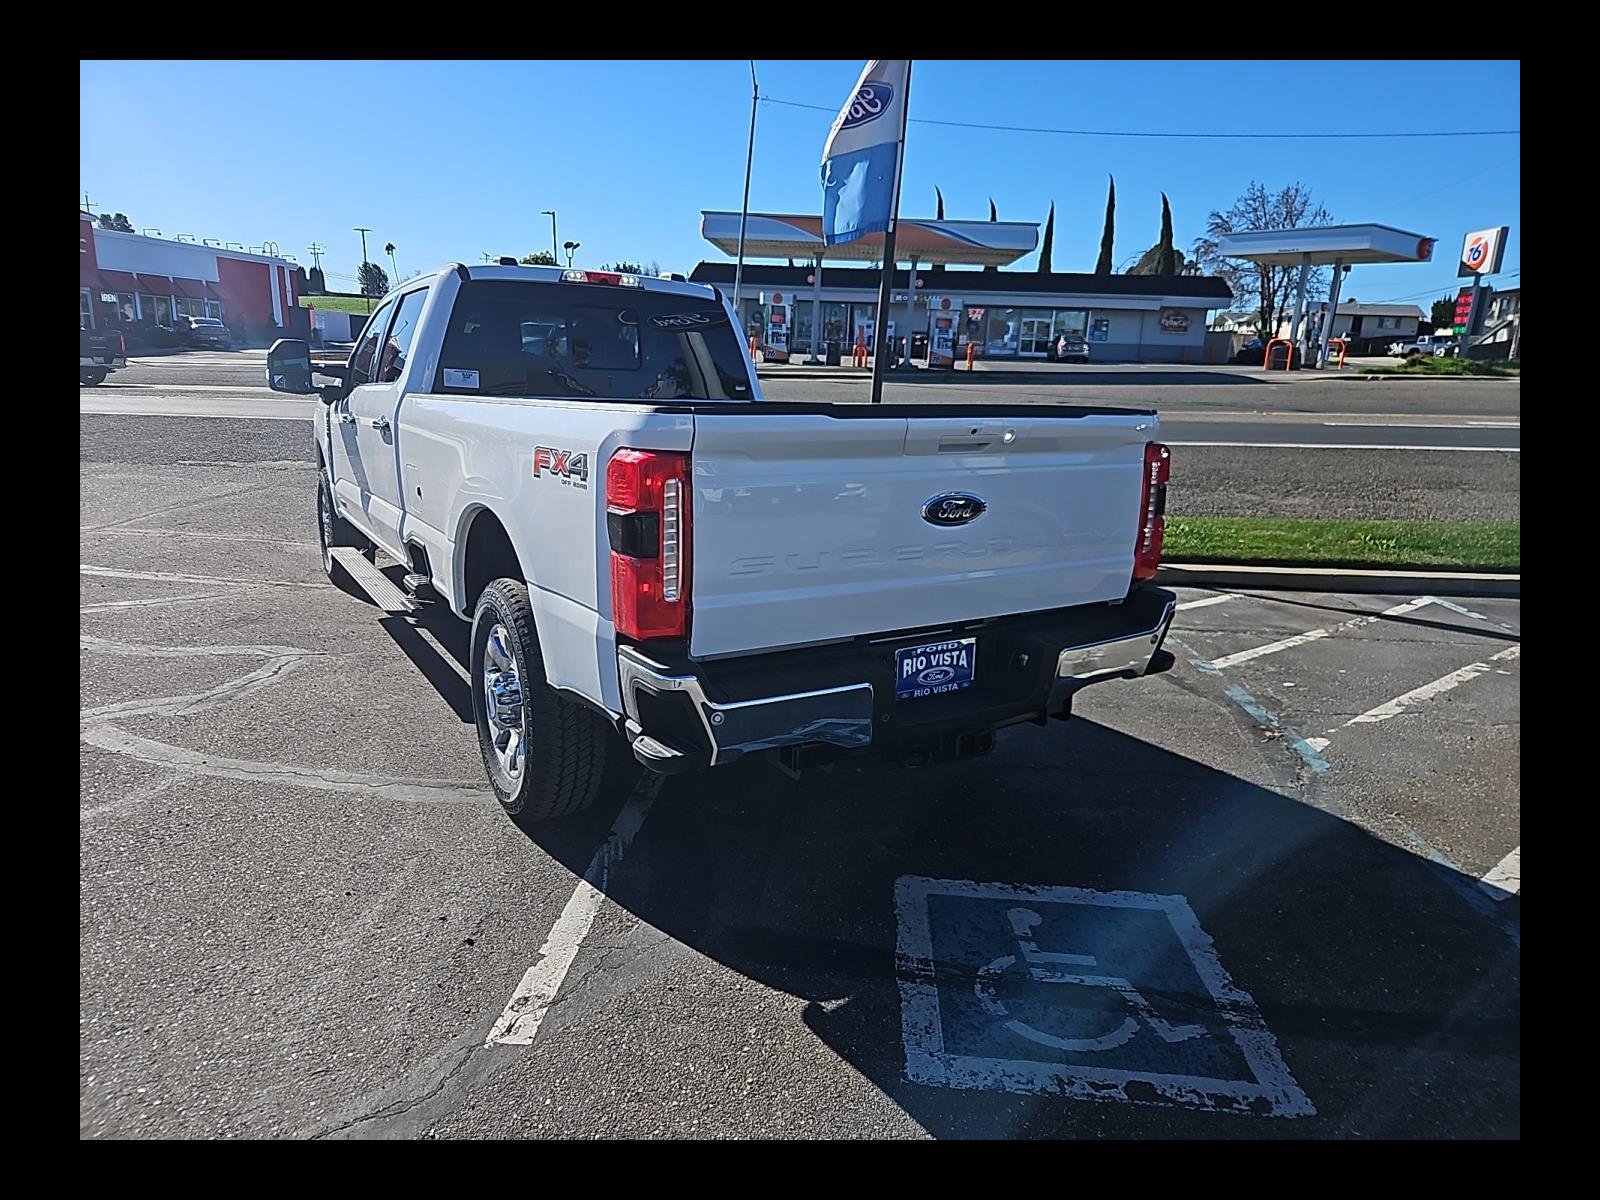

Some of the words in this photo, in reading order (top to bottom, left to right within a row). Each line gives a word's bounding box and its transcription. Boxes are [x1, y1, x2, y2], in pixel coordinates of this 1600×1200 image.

[1467, 241, 1482, 262] 76
[534, 446, 588, 481] FX4
[939, 500, 973, 518] Ford
[917, 643, 958, 653] FORD
[903, 656, 927, 679] RIO
[930, 650, 967, 668] VISTA
[927, 671, 945, 681] Ford
[914, 688, 931, 698] RIO
[932, 683, 959, 694] VISTA
